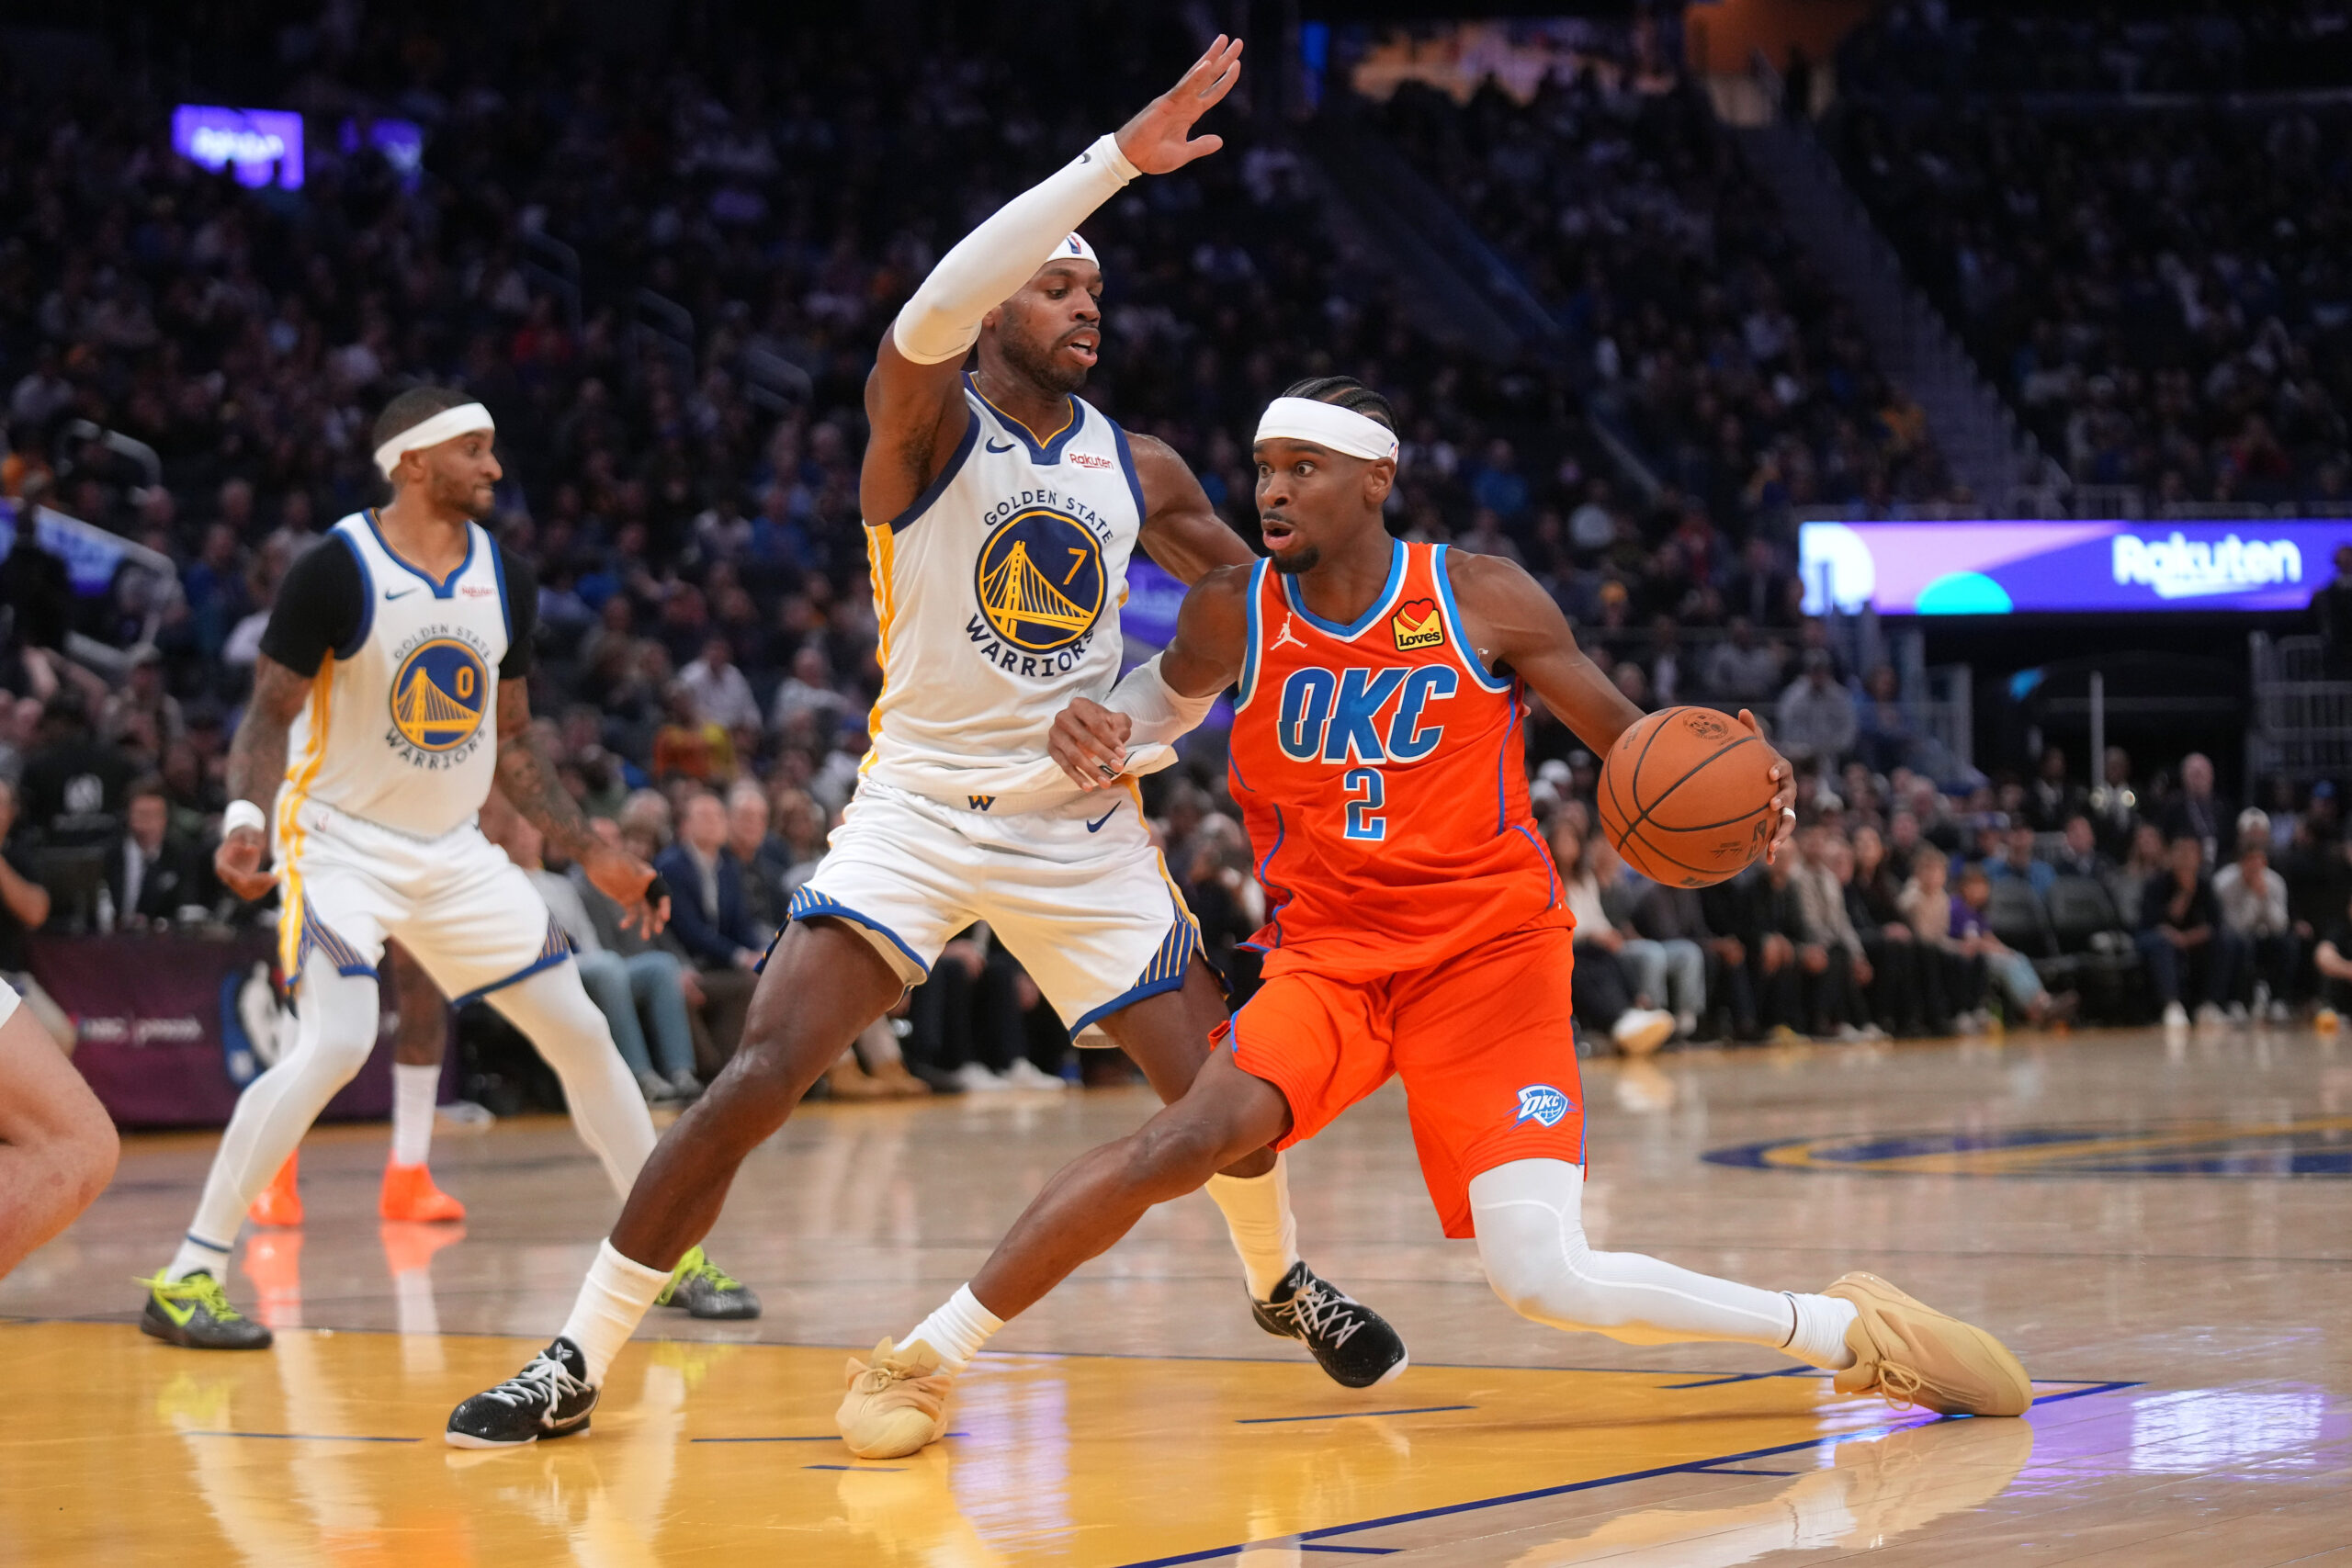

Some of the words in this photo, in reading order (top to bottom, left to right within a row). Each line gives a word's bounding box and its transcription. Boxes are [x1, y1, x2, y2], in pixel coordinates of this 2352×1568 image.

[1069, 454, 1114, 469] Rakuten
[984, 490, 1057, 525] GOLDEN
[1067, 497, 1114, 544] STATE
[1063, 547, 1088, 585] 7
[2112, 531, 2302, 598] Rakuten
[394, 625, 449, 659] GOLDEN
[457, 626, 492, 658] STATE
[966, 614, 1094, 677] WARRIORS
[457, 666, 474, 699] 0
[1277, 664, 1459, 764] OKC
[385, 727, 486, 770] WARRIORS
[967, 795, 997, 811] W
[1343, 766, 1386, 841] 2
[1518, 1095, 1560, 1119] OKC
